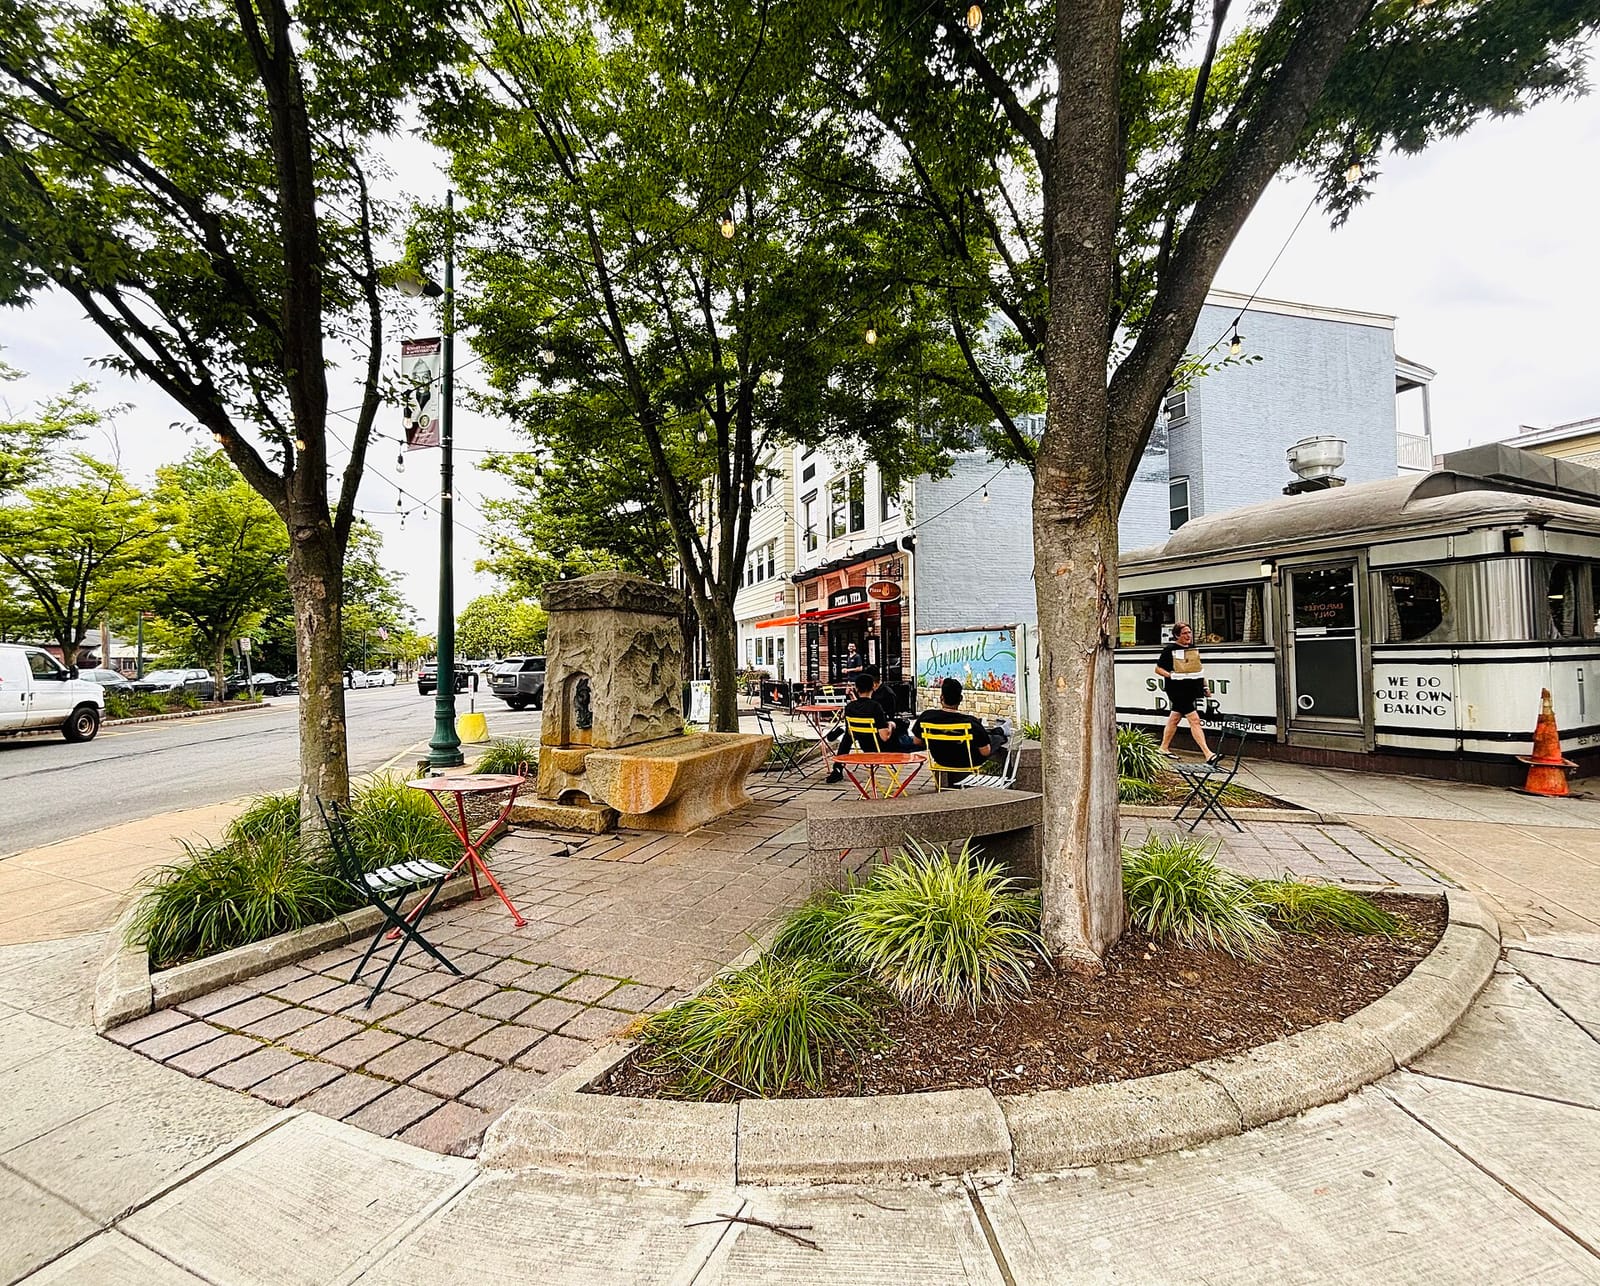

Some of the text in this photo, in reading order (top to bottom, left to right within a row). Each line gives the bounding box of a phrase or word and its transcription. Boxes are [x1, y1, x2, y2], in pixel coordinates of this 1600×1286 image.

[834, 592, 861, 607] PIZZA VITA
[1387, 676, 1441, 688] WE DO
[1375, 689, 1452, 702] OUR OWN
[1383, 703, 1447, 716] BAKING
